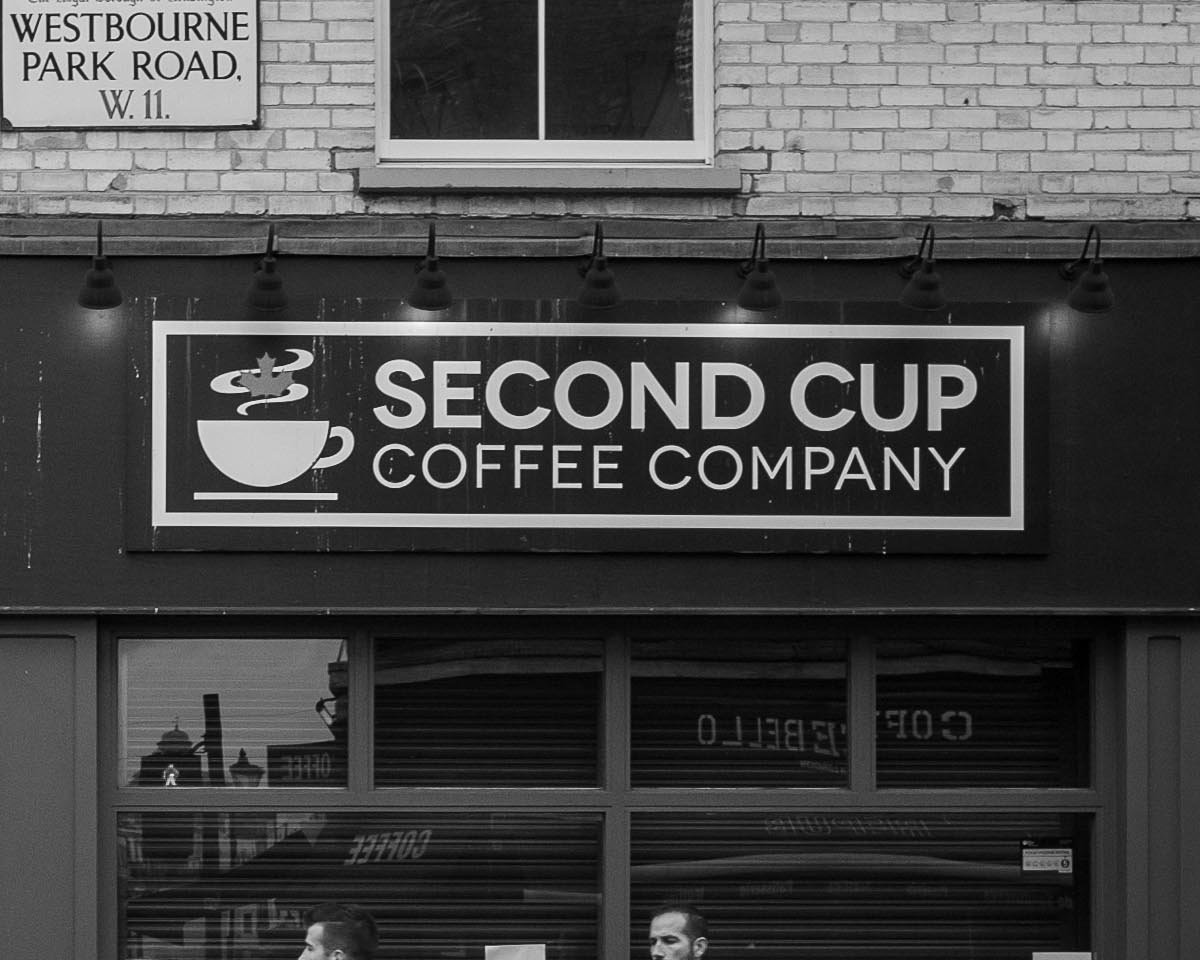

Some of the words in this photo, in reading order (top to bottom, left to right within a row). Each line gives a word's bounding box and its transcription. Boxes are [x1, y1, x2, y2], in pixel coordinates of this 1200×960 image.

[10, 12, 249, 42] WESTBOURNE
[22, 51, 116, 81] PARK
[133, 50, 242, 82] ROAD,
[372, 358, 765, 430] SECOND
[790, 361, 981, 432] CUP
[372, 443, 623, 491] COFFEE
[648, 443, 966, 492] COMPANY
